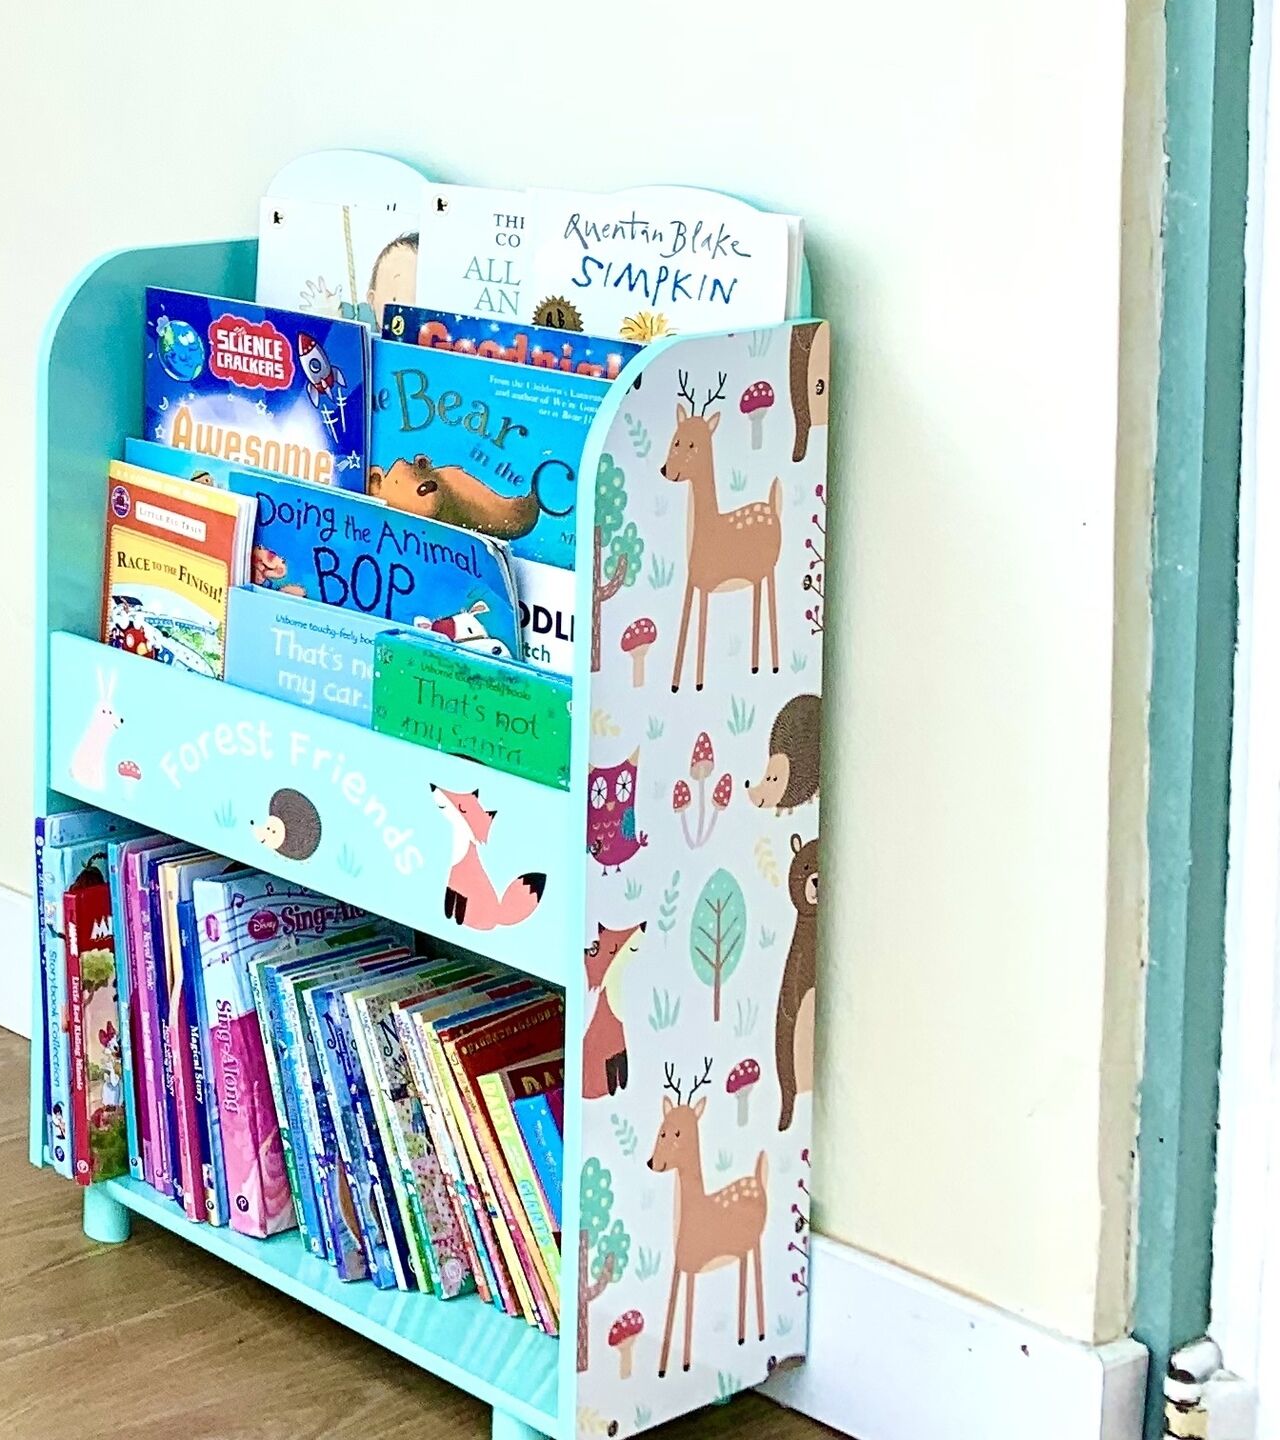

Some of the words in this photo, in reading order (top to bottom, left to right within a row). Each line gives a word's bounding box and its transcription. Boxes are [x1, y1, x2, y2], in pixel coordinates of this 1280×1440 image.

[564, 211, 666, 251] Quentin
[659, 220, 752, 258] Blake
[463, 255, 522, 286] ALL
[572, 256, 738, 306] SIMPKIN
[216, 329, 284, 362] SCIENCE
[216, 352, 285, 380] CRACKERS
[392, 367, 528, 451] Bear
[171, 405, 332, 486] Awesome
[470, 444, 489, 461] in
[492, 462, 524, 488] the
[256, 491, 337, 540] Doing
[344, 514, 372, 543] the
[376, 519, 482, 578] Animal
[117, 551, 151, 572] RACE
[152, 561, 163, 571] TO
[164, 564, 178, 575] THE
[178, 565, 223, 603] FINISH!
[313, 546, 416, 618] BOP
[270, 625, 343, 672] That's
[278, 670, 316, 705] my
[413, 676, 485, 722] That's
[495, 711, 540, 740] not
[159, 718, 274, 791] Forest
[289, 729, 425, 876] Friends
[45, 949, 60, 1018] Storybook
[50, 1021, 63, 1089] Collection
[188, 1024, 204, 1070] Magical
[214, 998, 241, 1114] Sing-Along
[192, 1072, 206, 1104] Story
